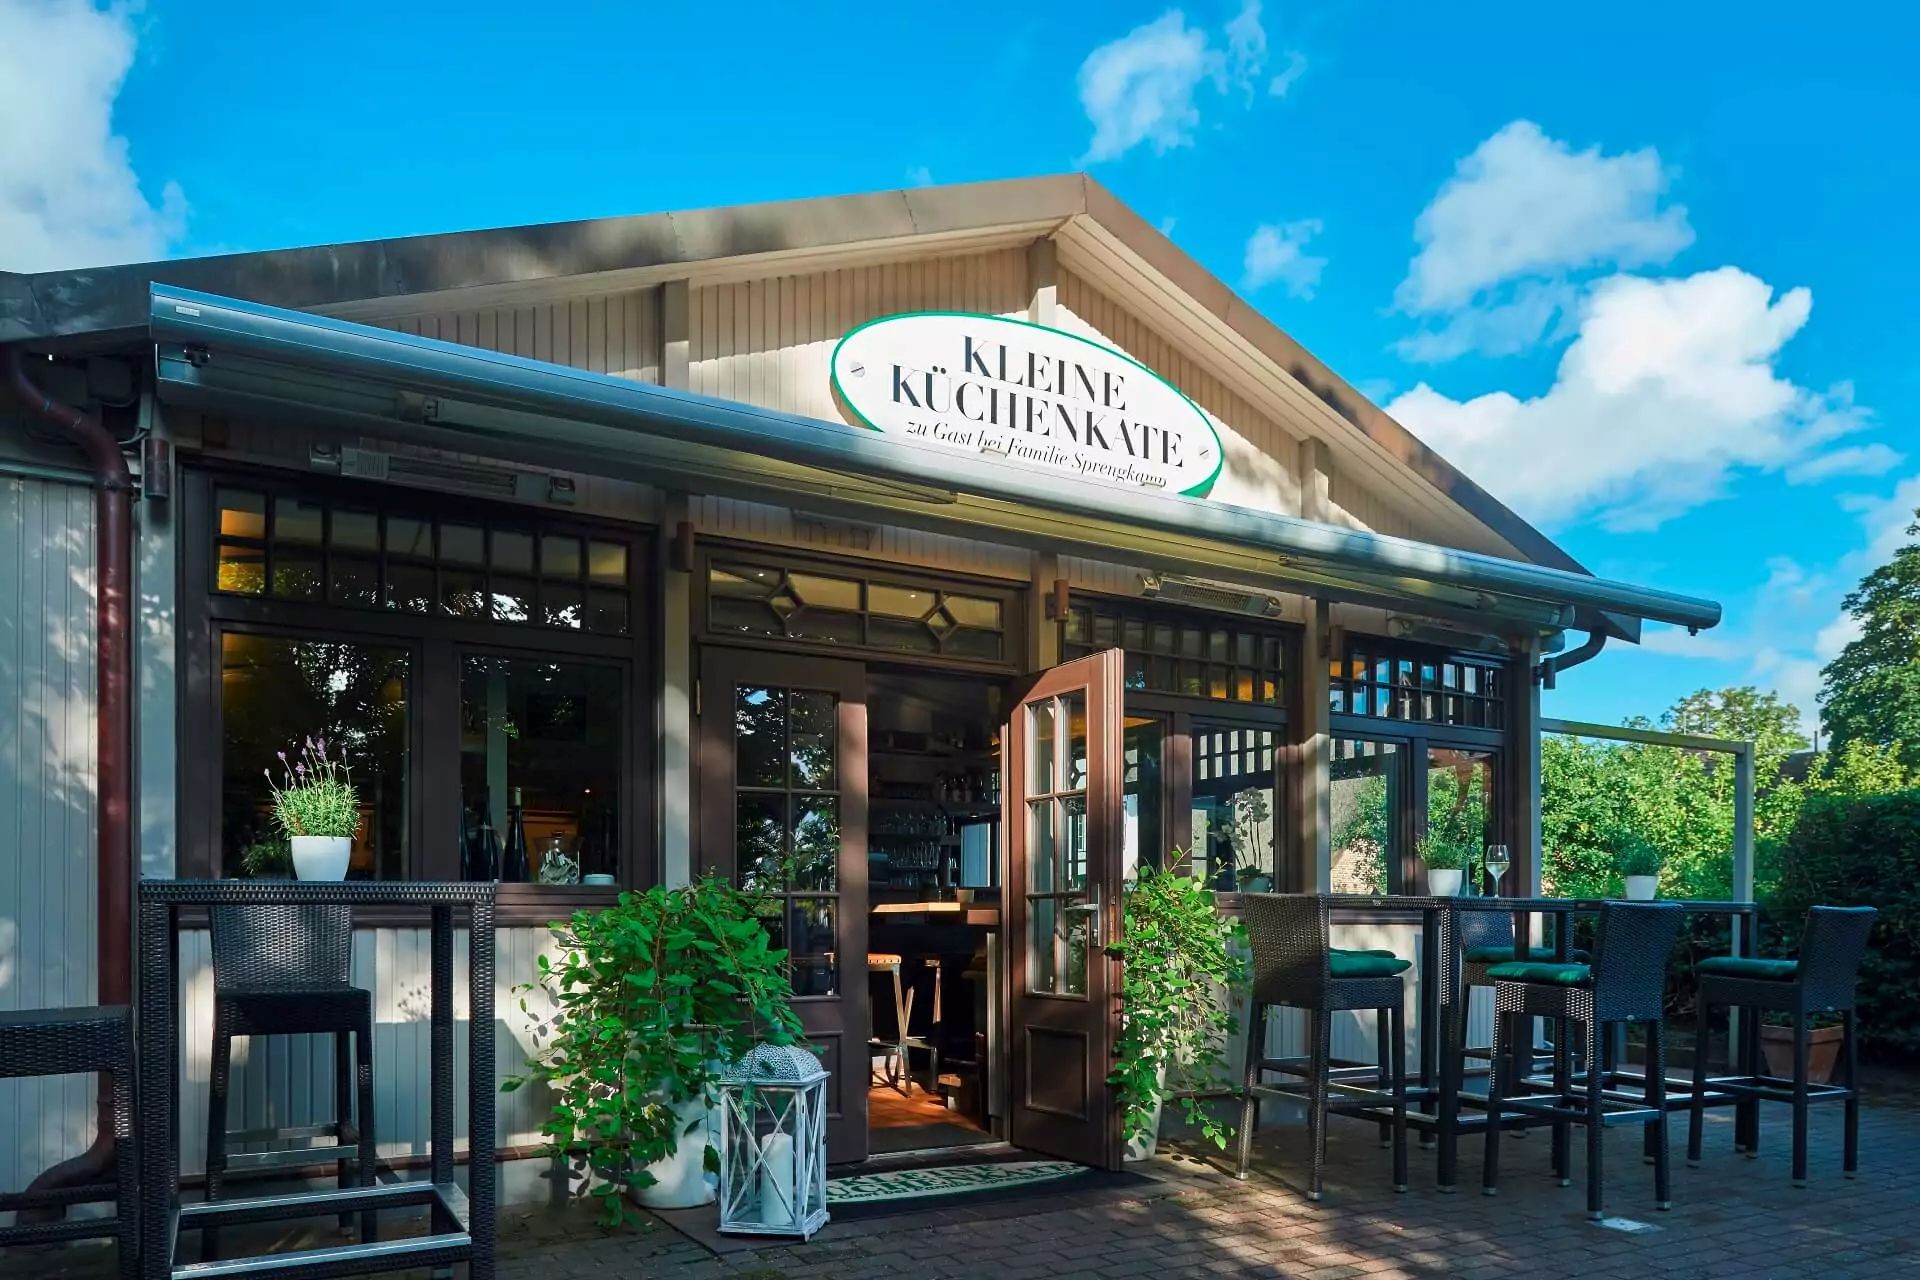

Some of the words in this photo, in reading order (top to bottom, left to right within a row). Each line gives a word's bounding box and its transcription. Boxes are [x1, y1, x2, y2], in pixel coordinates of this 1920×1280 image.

[963, 335, 1126, 411] KLEINE
[890, 361, 1184, 468] KÜCHENKATE
[905, 420, 928, 437] zu
[933, 421, 972, 446] Gast
[977, 429, 1004, 450] bei
[1008, 437, 1069, 465] Familie
